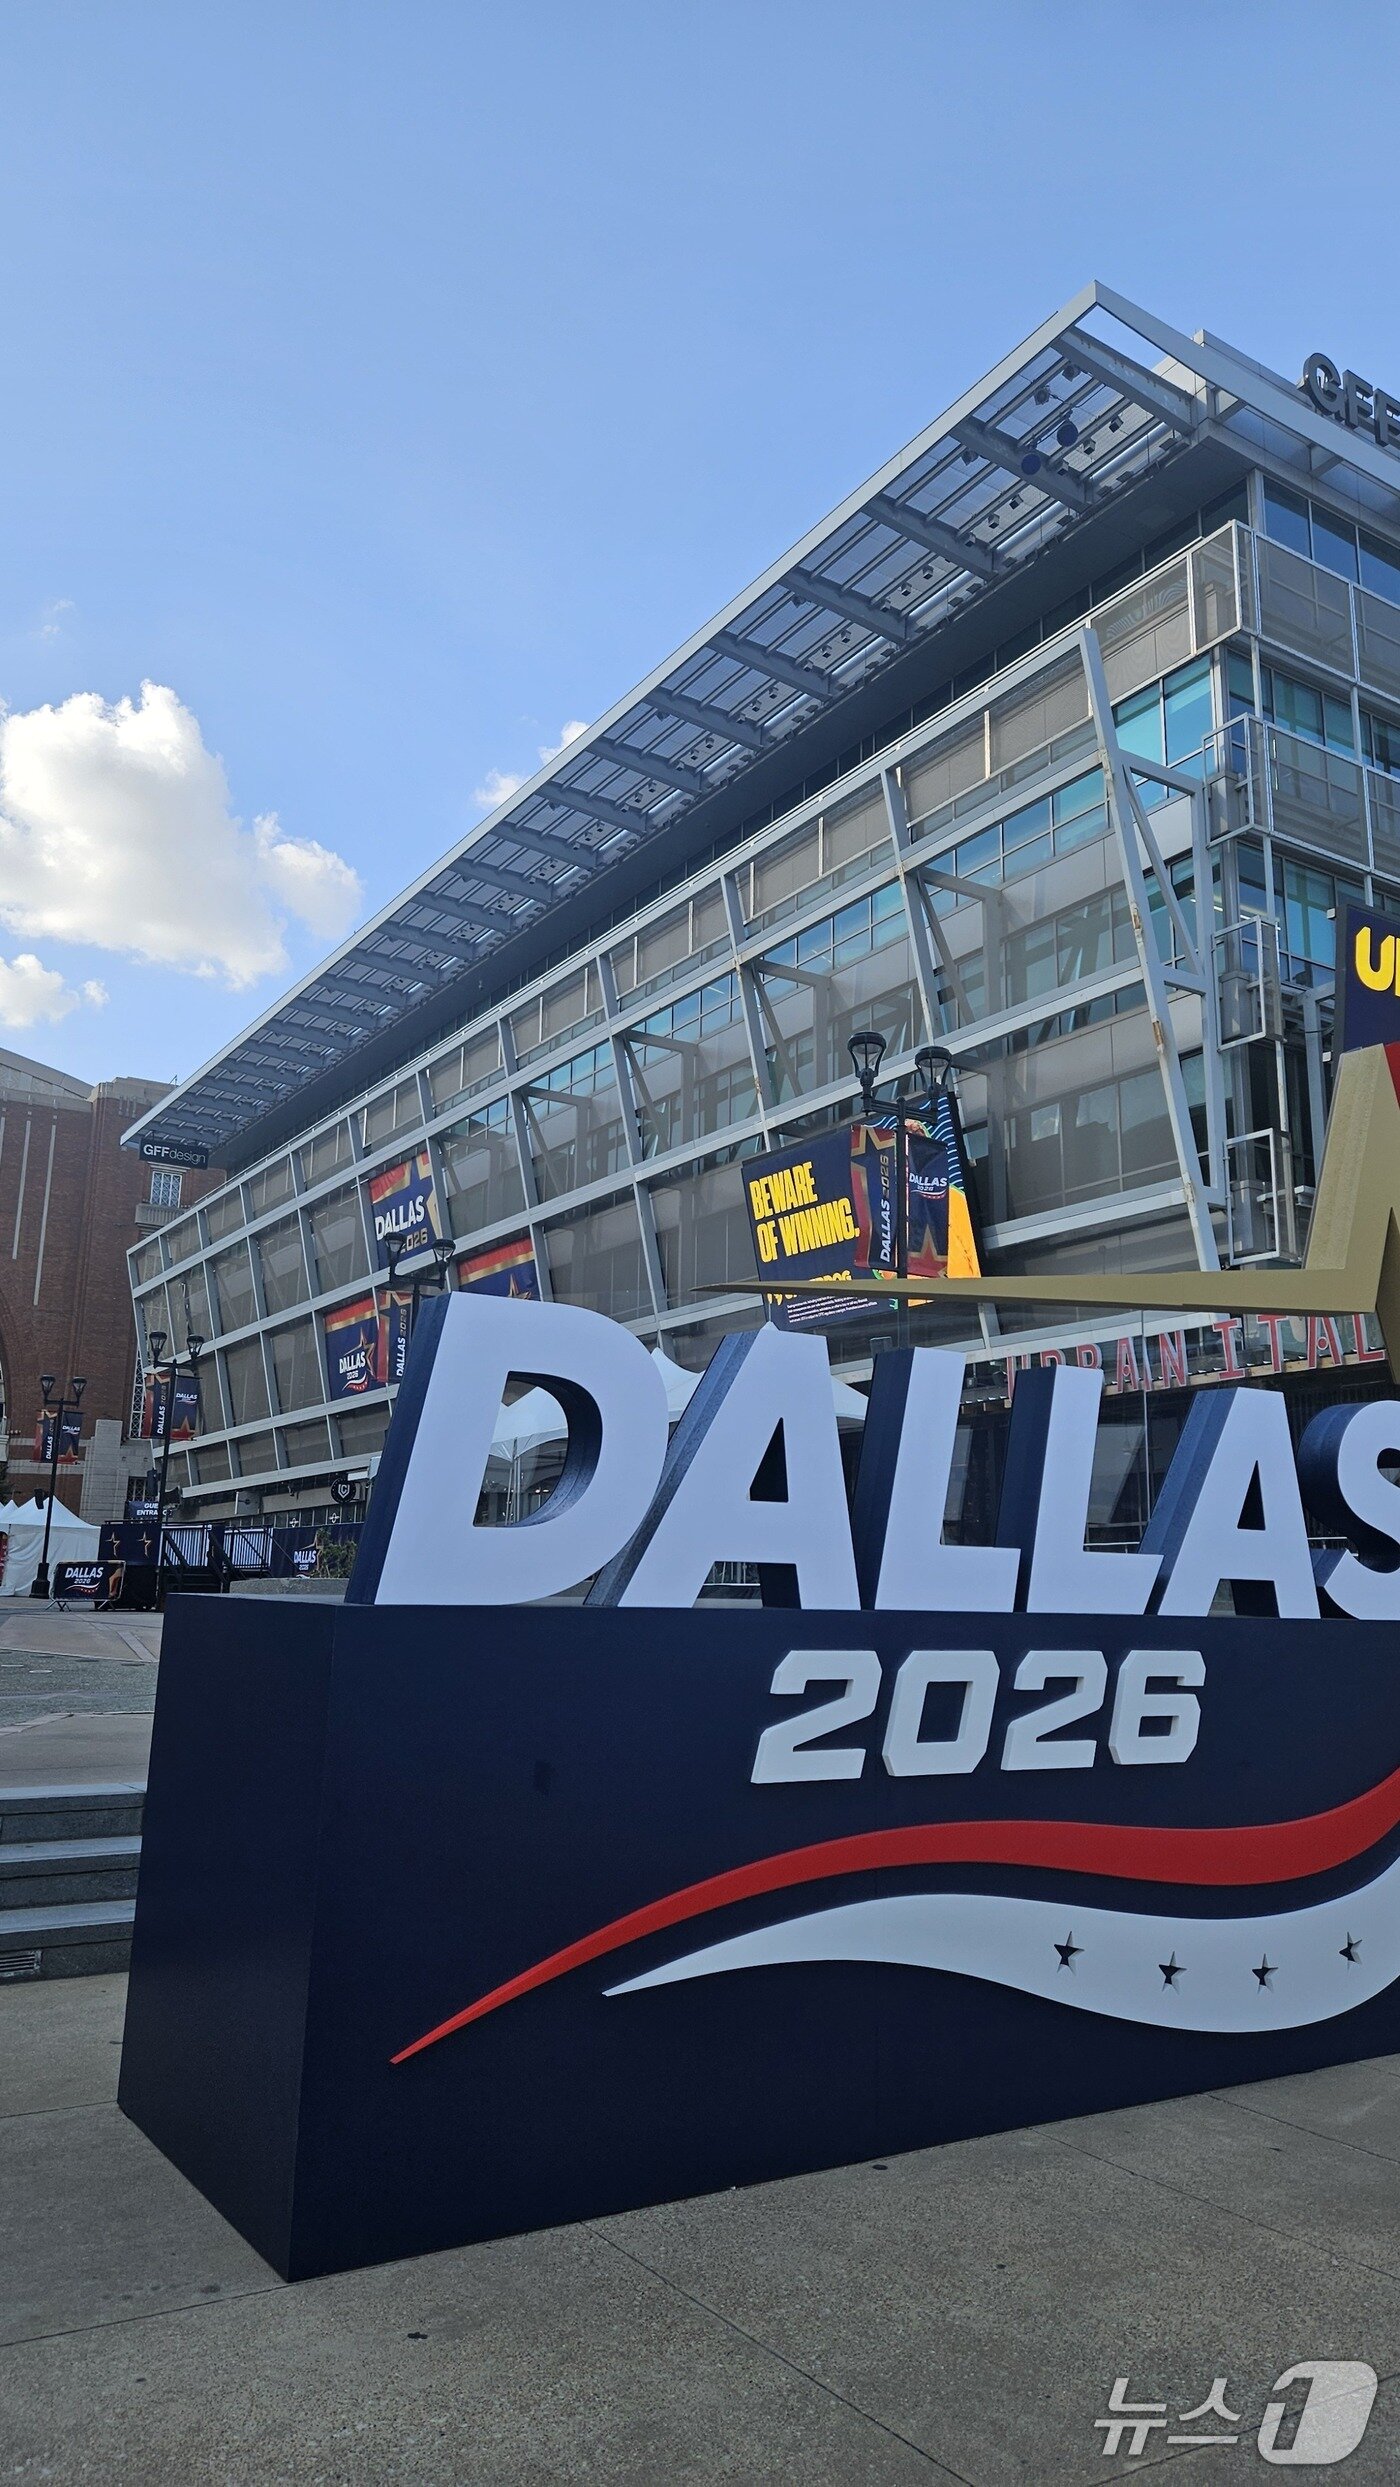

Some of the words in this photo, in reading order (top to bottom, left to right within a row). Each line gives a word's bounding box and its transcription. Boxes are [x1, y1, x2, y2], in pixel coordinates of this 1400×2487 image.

[1355, 926, 1400, 998] U
[143, 1144, 206, 1165] GFFdesign
[749, 1160, 819, 1221] BEWARE
[909, 1172, 948, 1187] DALLAS
[375, 1195, 425, 1241] DALLAS
[755, 1219, 780, 1263] OF
[777, 1197, 860, 1256] WINNING.
[880, 1199, 892, 1263] DALLAS
[401, 1227, 429, 1253] 026
[339, 1351, 366, 1374] DALLAS
[396, 1337, 406, 1377] DALLAS
[176, 1392, 198, 1400] DALLAS
[157, 1406, 166, 1434] DALLAS
[46, 1436, 54, 1459] DALLAS
[374, 1291, 1400, 1621] DALLAS
[293, 1550, 317, 1564] DALLAS
[65, 1567, 104, 1579] DALLAS
[751, 1650, 1206, 1784] 2026
